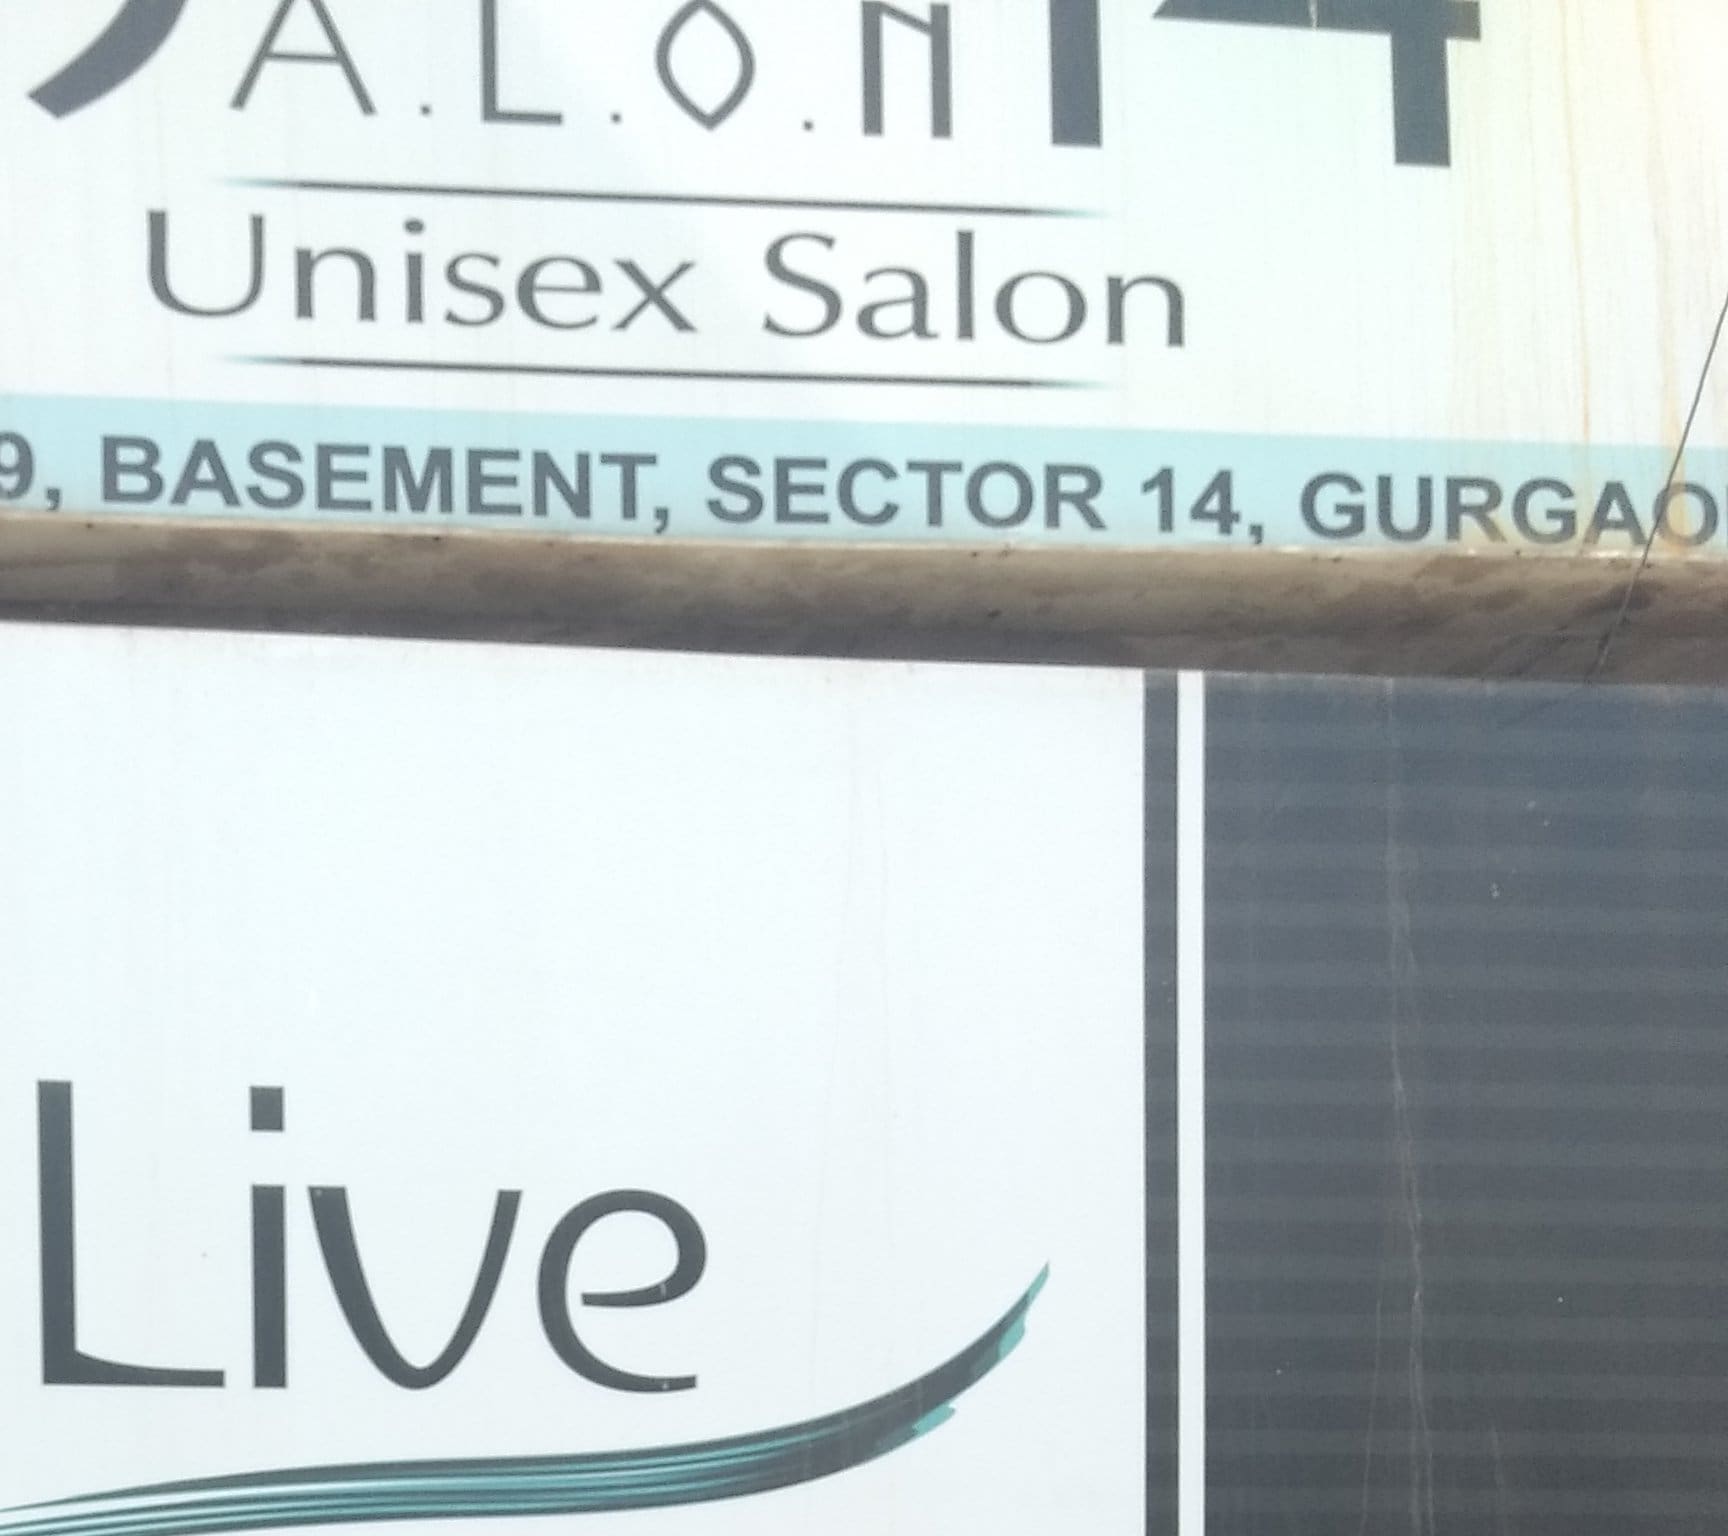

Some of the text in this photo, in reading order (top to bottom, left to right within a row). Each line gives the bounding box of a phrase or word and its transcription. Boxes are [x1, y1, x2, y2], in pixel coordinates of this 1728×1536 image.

[146, 208, 1187, 349] Unisex Salon
[99, 435, 669, 535] BASEMENT,
[705, 455, 1107, 531] SECTOR
[1141, 467, 1265, 546] 14,
[1300, 471, 1728, 547] GURGAO
[37, 1079, 708, 1394] Live
